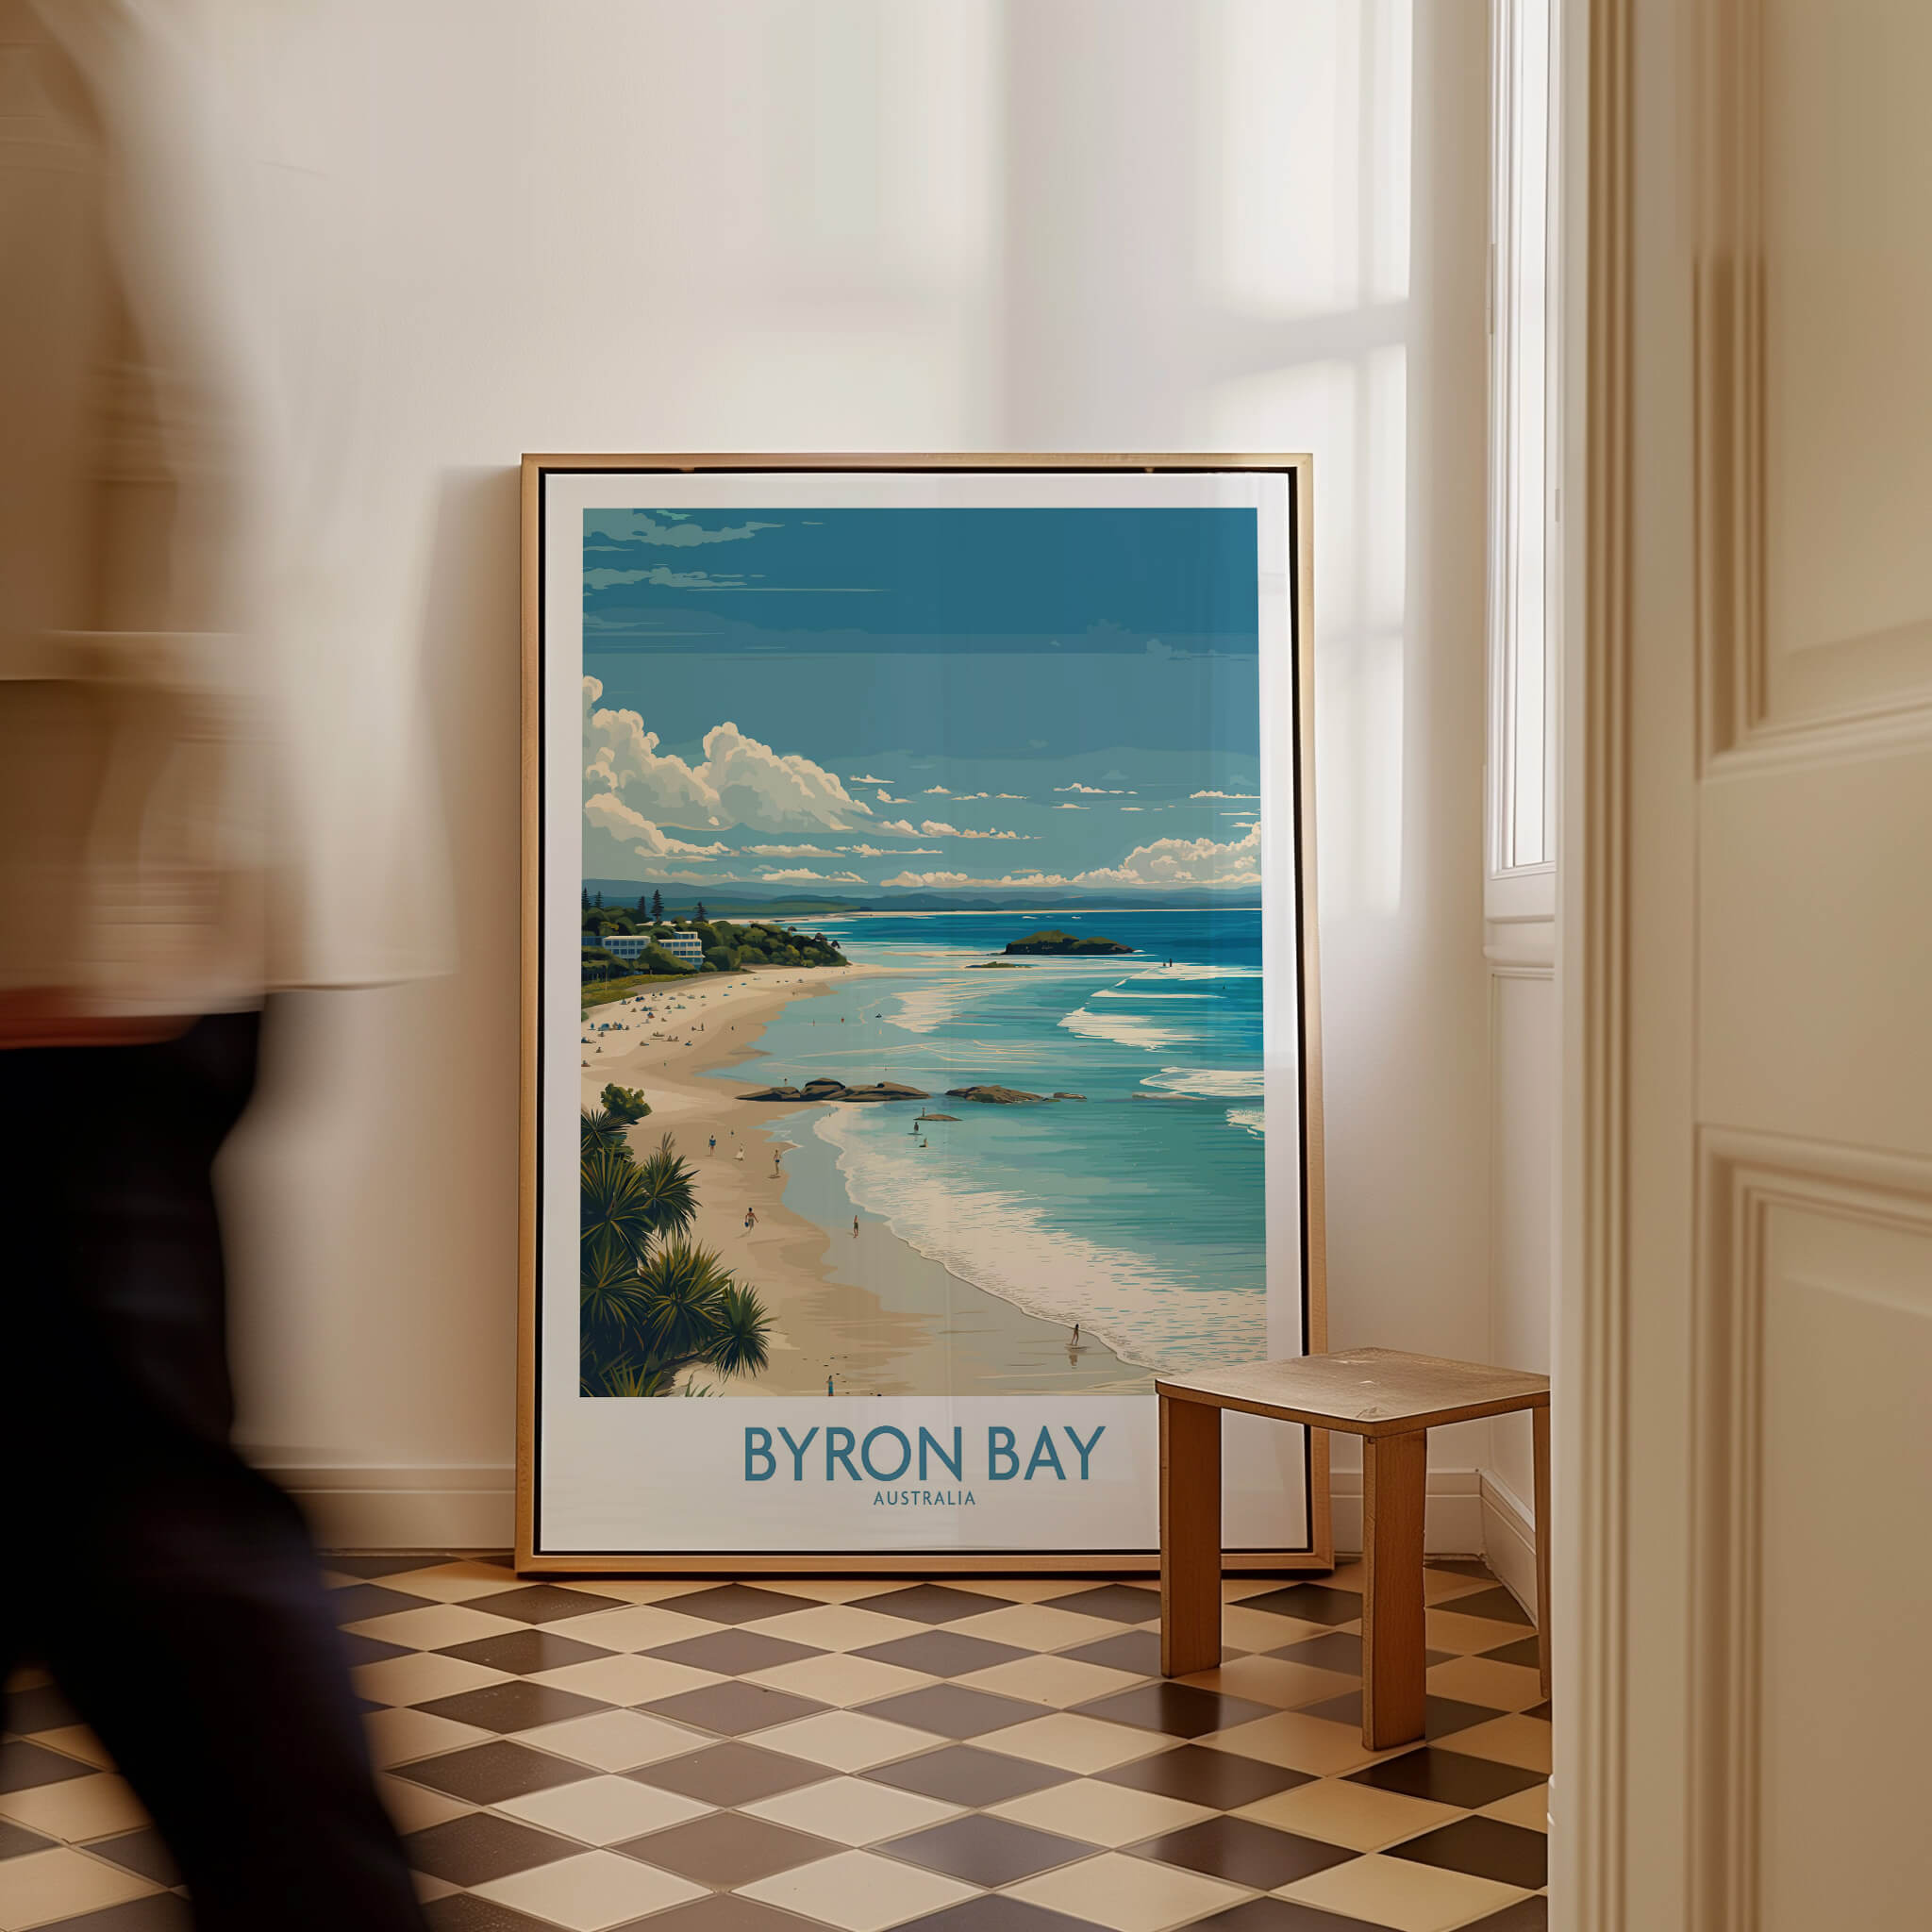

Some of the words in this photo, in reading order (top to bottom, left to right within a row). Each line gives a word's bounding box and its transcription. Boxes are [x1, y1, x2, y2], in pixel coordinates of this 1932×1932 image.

[744, 1425, 963, 1482] BYRON
[988, 1425, 1107, 1481] BAY
[873, 1491, 976, 1506] AUSTRALIA
